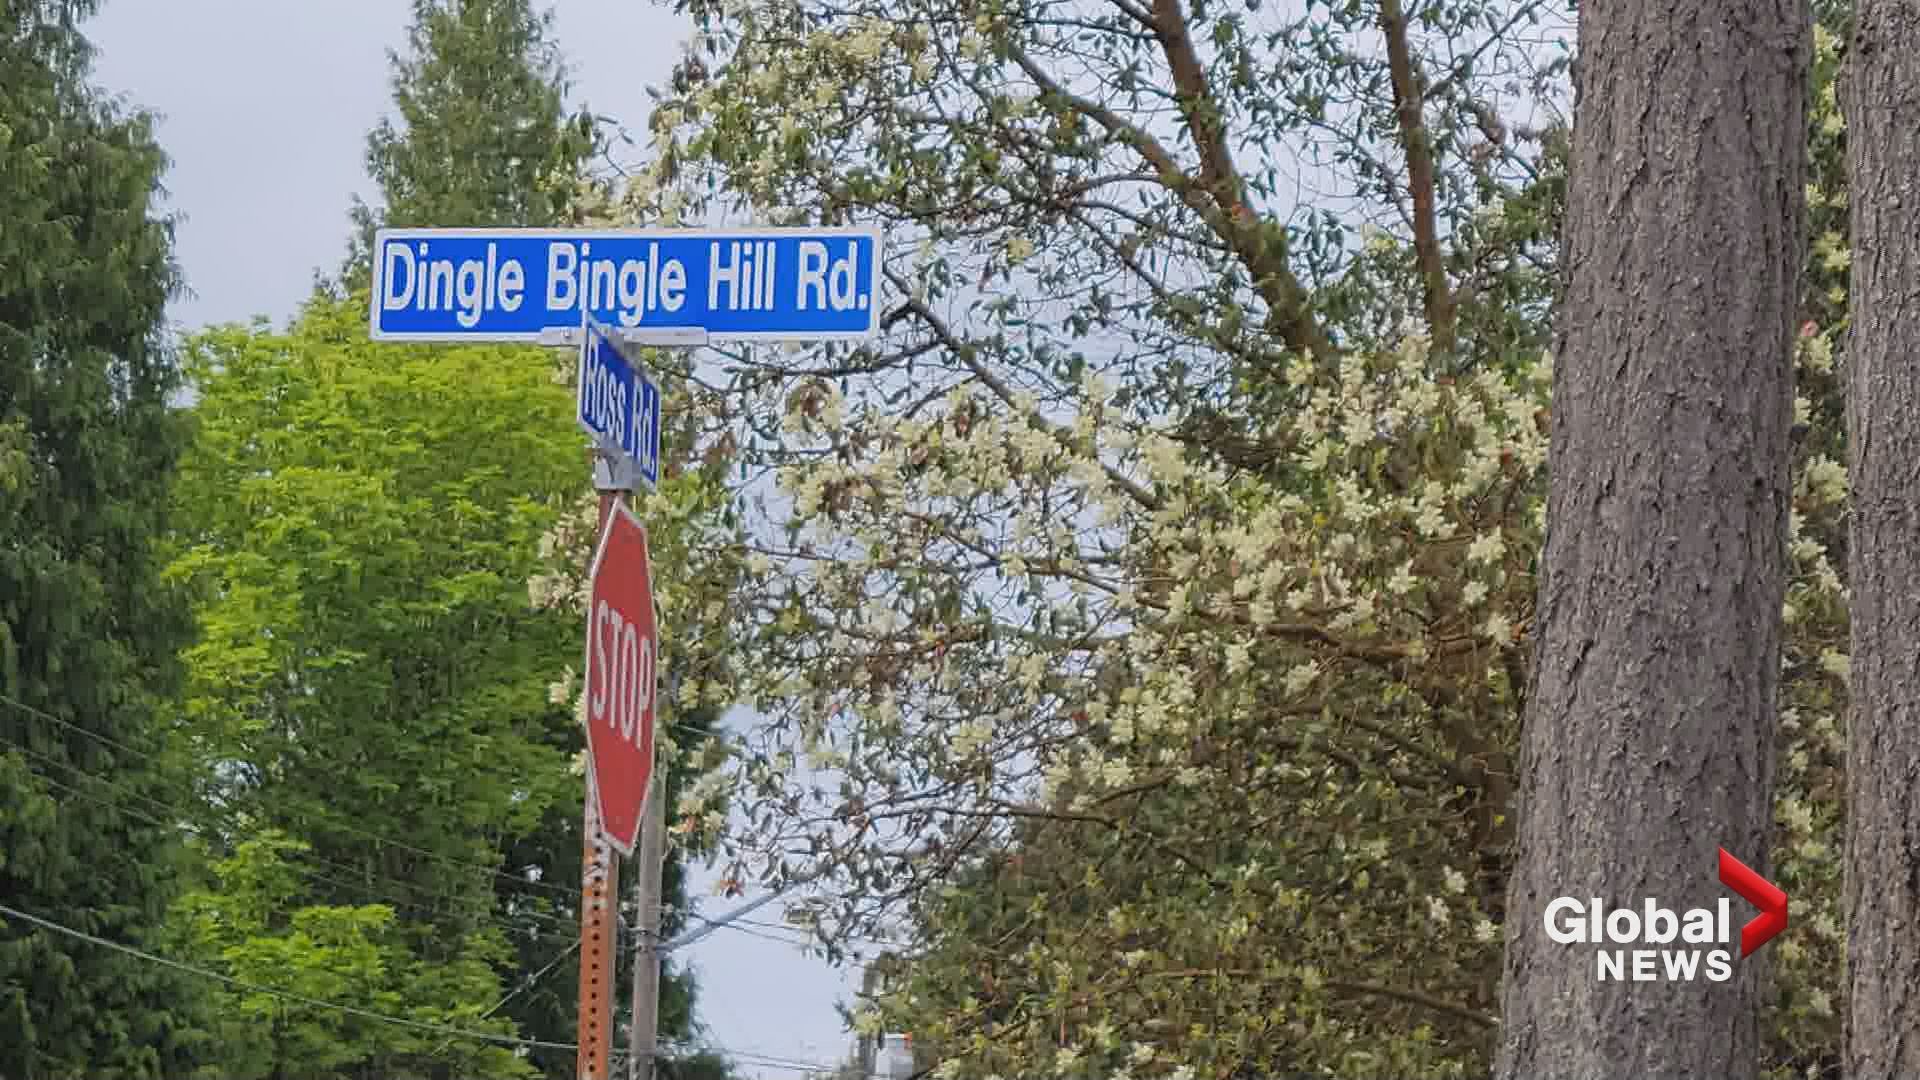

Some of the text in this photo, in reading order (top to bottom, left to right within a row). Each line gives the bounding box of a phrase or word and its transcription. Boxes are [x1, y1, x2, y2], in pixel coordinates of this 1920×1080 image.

[383, 241, 869, 327] Dingle Bingle Hill Rd.
[584, 333, 627, 448] Ross
[593, 600, 651, 749] STOP
